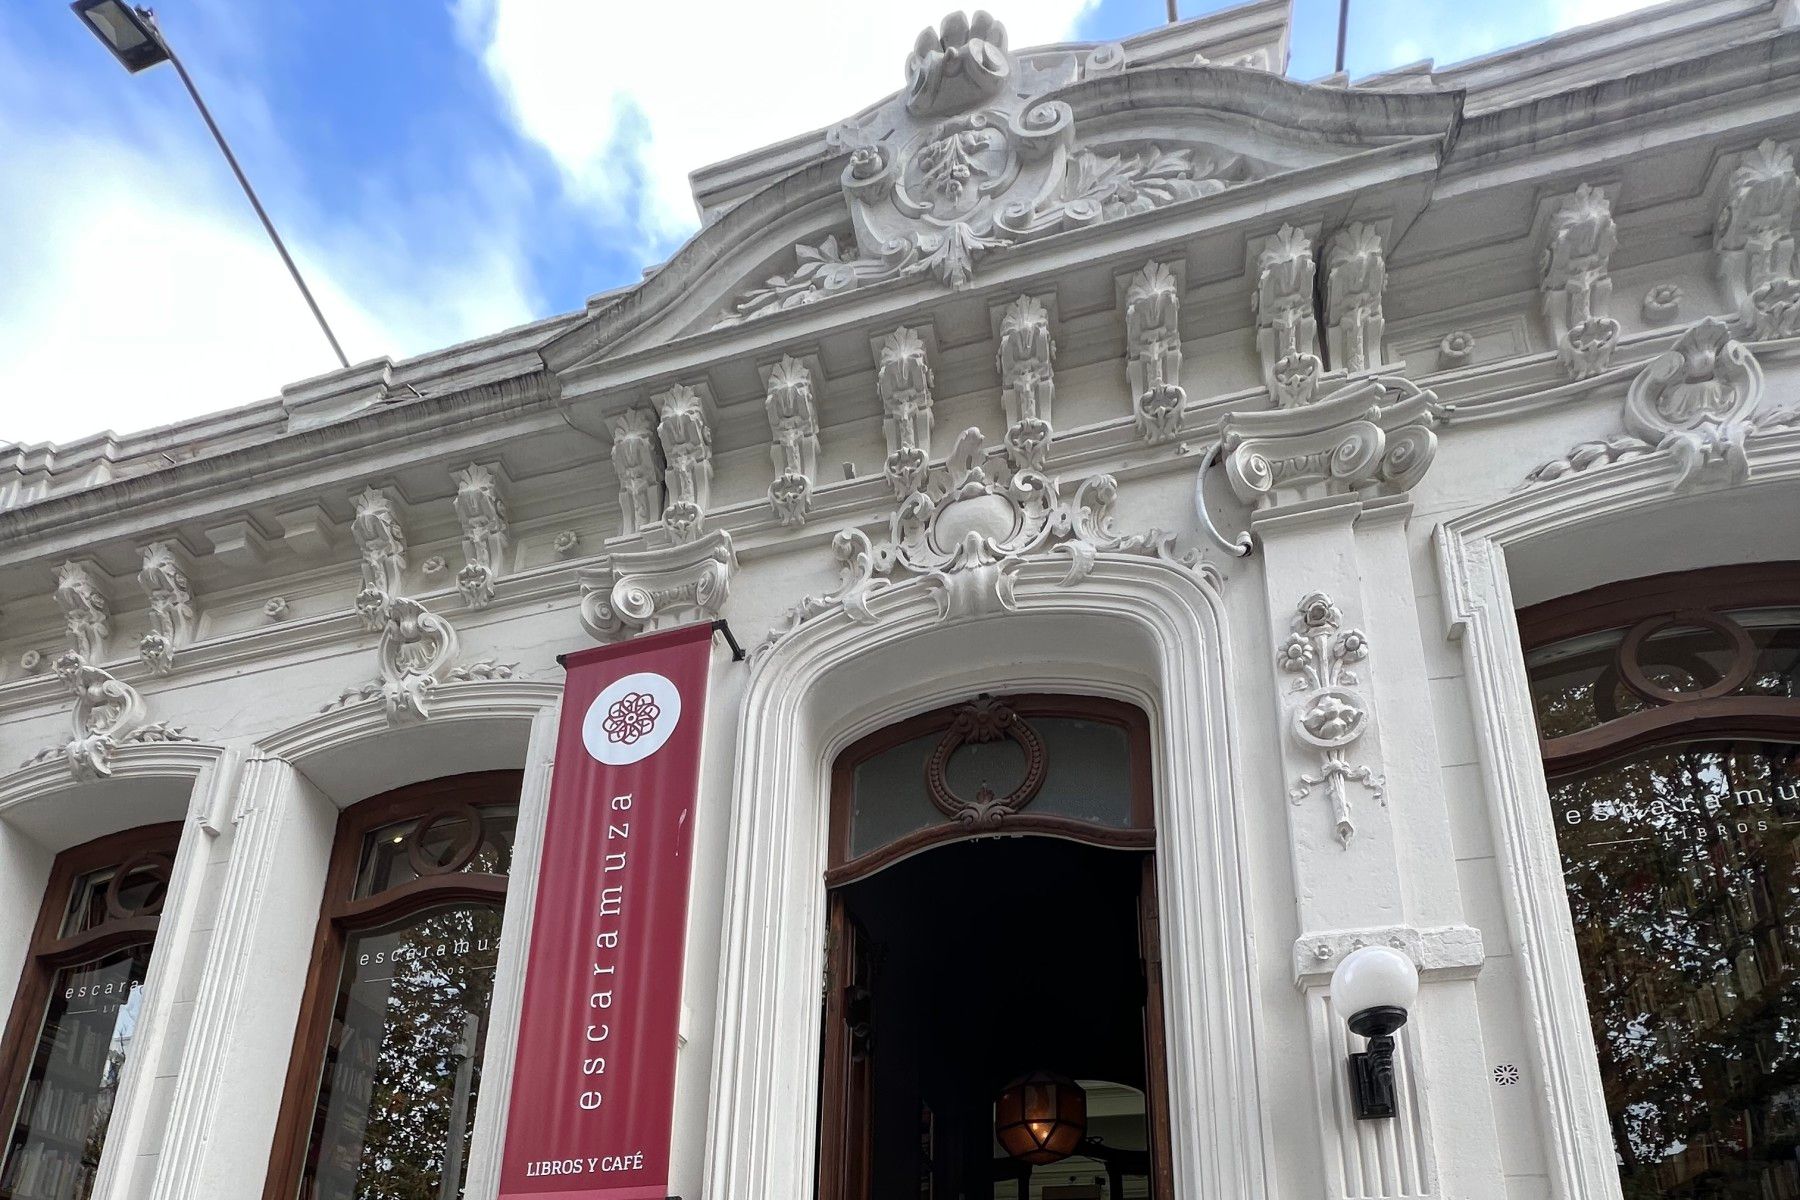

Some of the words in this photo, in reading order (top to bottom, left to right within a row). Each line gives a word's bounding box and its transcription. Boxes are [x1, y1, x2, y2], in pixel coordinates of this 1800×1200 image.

[1665, 820, 1768, 841] LIBROS
[579, 793, 633, 1110] escaramuza
[526, 1159, 583, 1177] LIBROS
[587, 1158, 598, 1173] Y
[601, 1151, 644, 1172] CAFÉ
